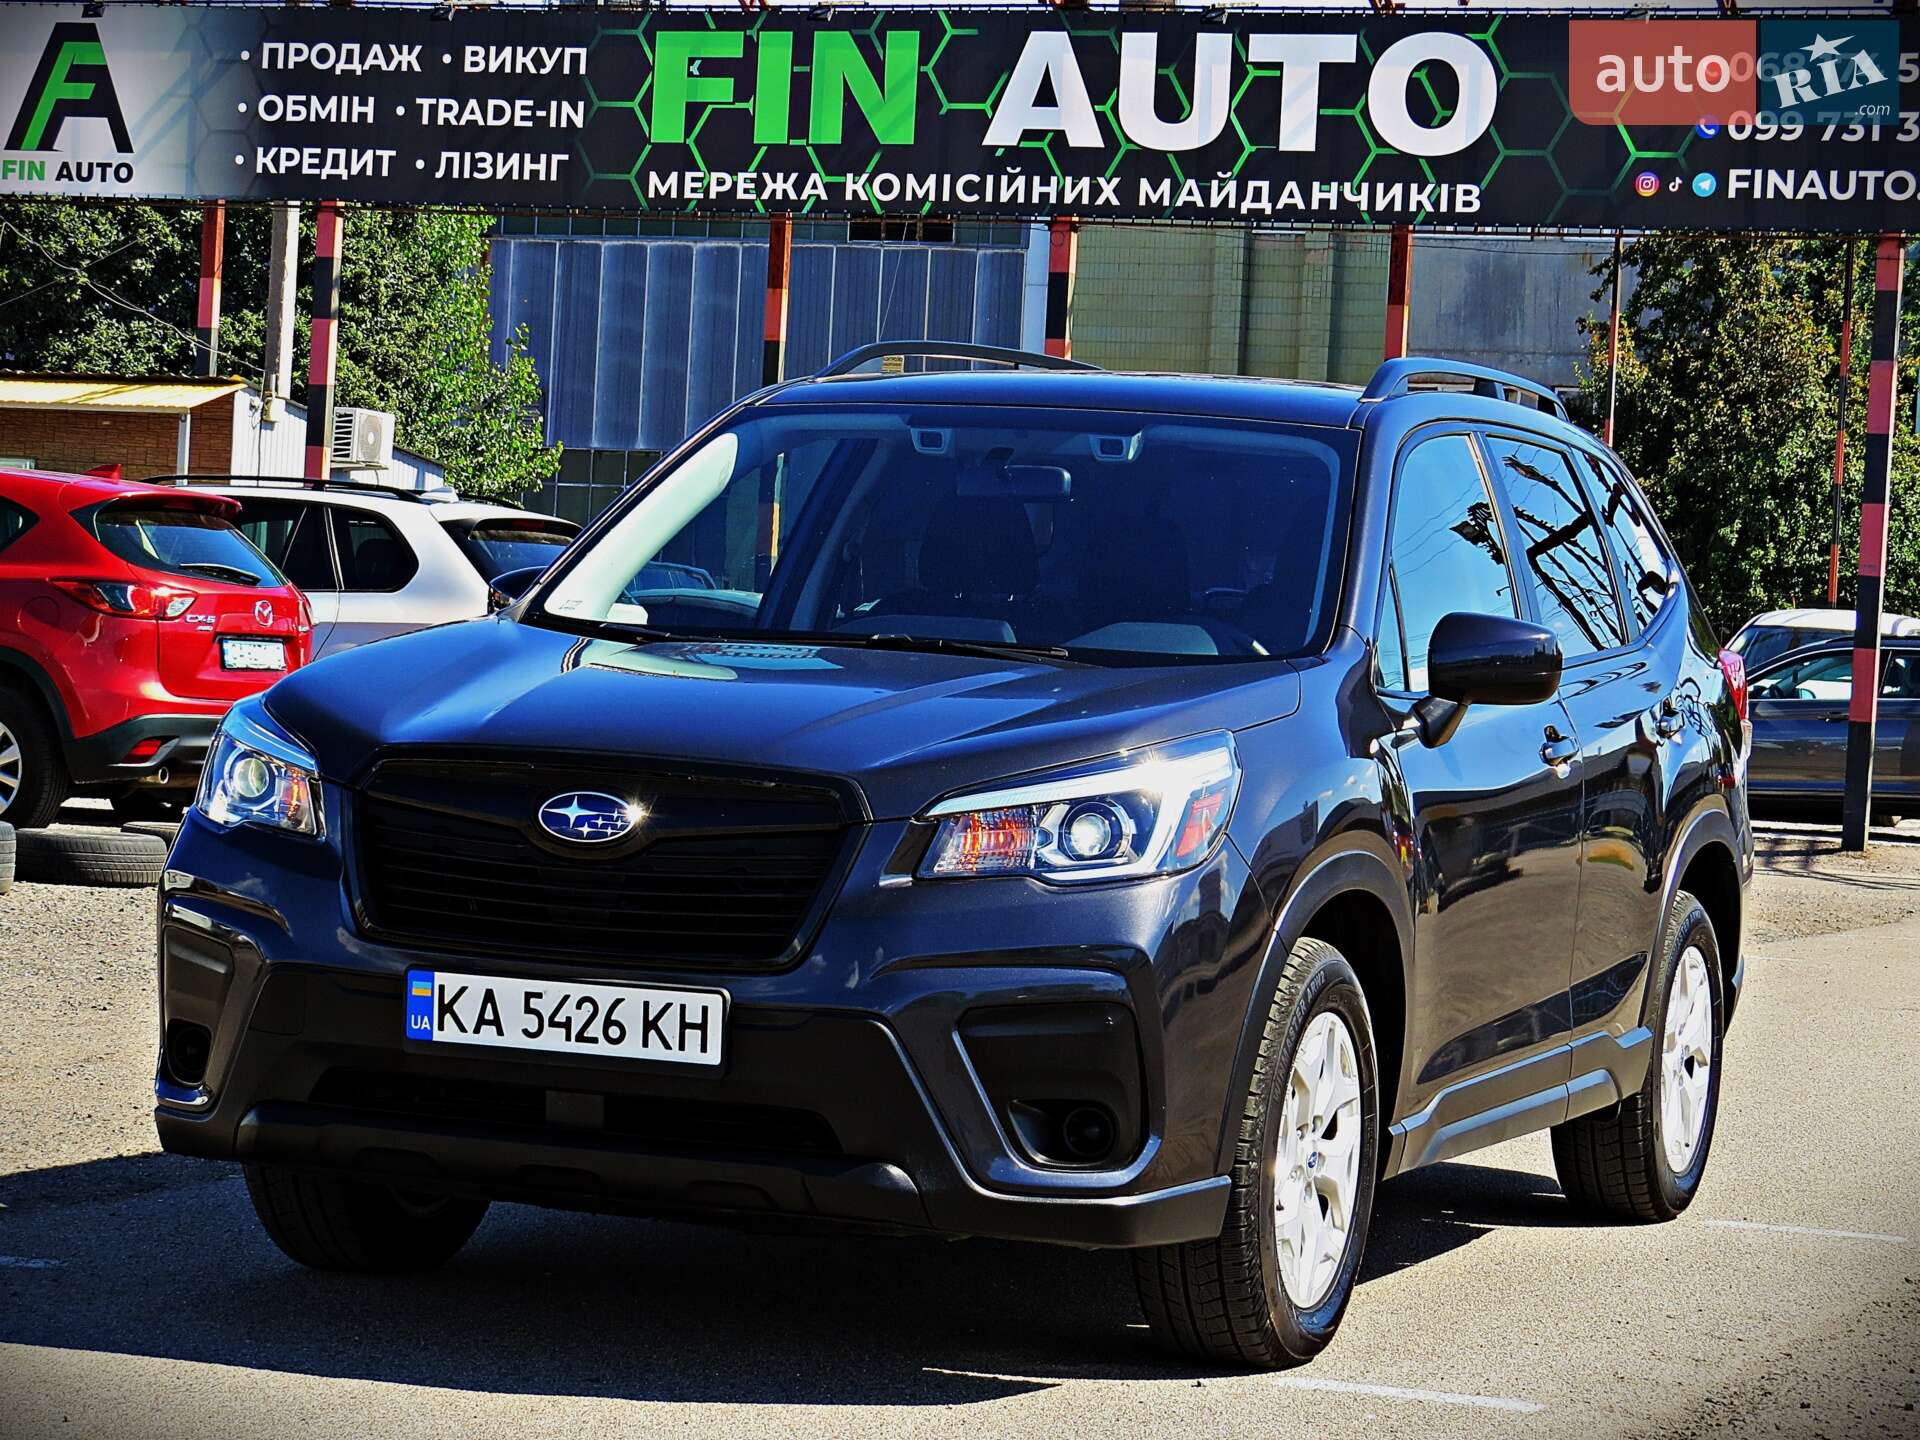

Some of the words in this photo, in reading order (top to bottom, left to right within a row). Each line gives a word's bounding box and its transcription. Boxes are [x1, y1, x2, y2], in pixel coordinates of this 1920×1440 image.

[262, 43, 422, 75] ПРОДАЖ
[464, 46, 588, 75] ВИКУП
[649, 30, 919, 145] FIN
[981, 31, 1498, 156] AUTO
[258, 95, 375, 123] ОБМІН
[416, 98, 585, 128] TRADE-IN
[1728, 110, 1805, 142] 099
[2, 160, 45, 181] FIN
[55, 161, 134, 183] AUTO
[256, 147, 396, 180] КРЕДИТ
[435, 152, 569, 181] ЛІЗИНГ
[647, 170, 828, 203] МЕРЕЖА
[843, 166, 1122, 207] КОМІСІЙНИХ
[1139, 172, 1481, 214] МАЙДАНЧИКІВ
[411, 1014, 431, 1030] UA
[436, 983, 505, 1037] KA
[521, 991, 627, 1046] 5426
[641, 1000, 709, 1054] KH
